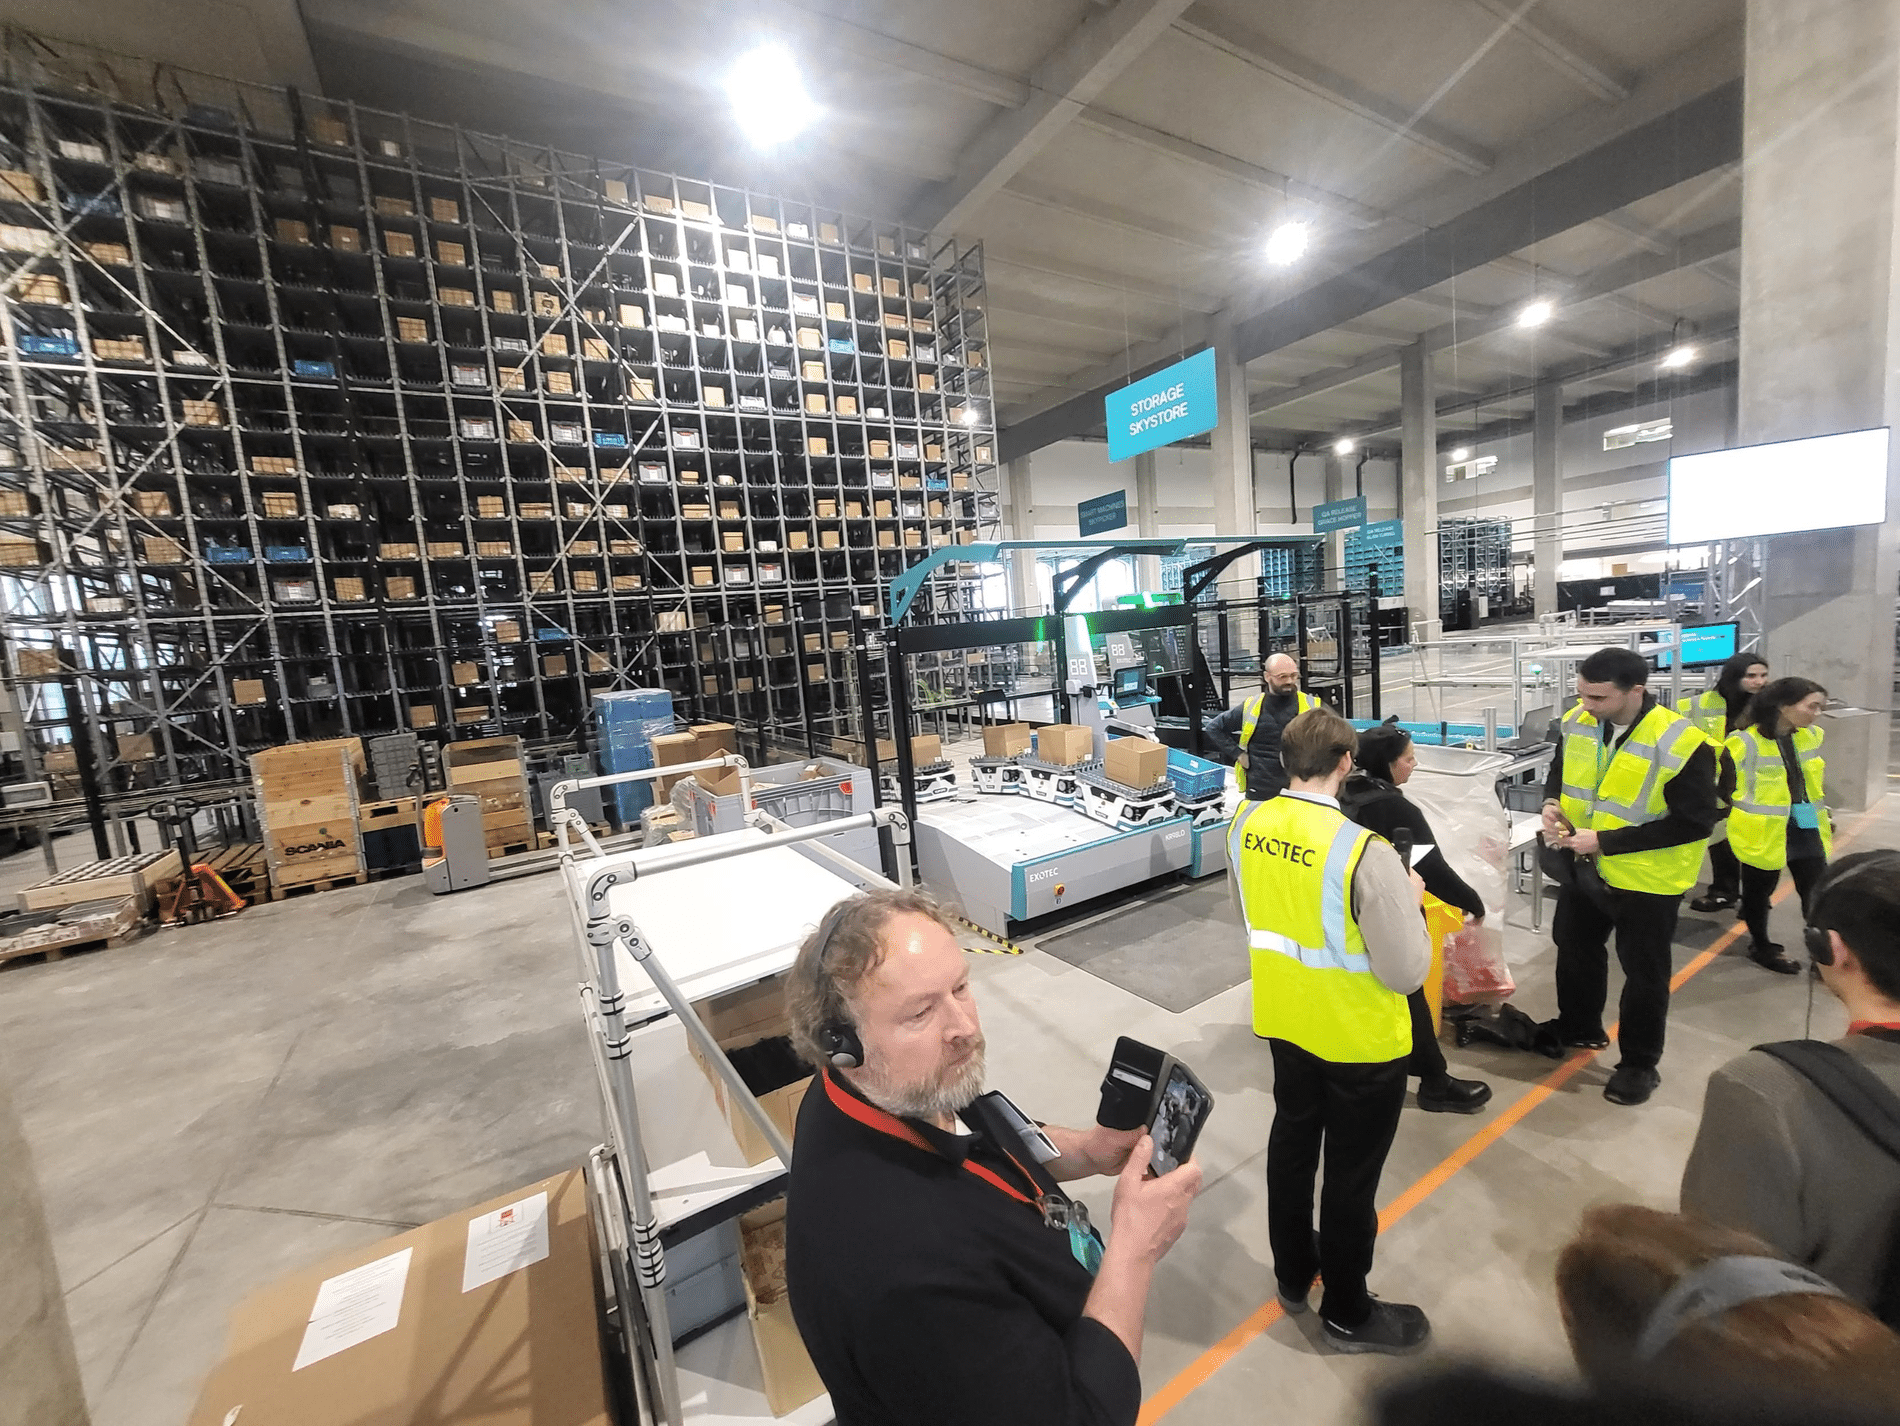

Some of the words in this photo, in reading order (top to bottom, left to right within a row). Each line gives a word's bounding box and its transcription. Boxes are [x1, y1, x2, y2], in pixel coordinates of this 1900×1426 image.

[1130, 382, 1185, 417] STORAGE
[1129, 402, 1188, 436] SKYSTORE
[284, 839, 346, 856] SCANIA
[1244, 832, 1316, 867] EXOTEC
[1029, 867, 1059, 883] EXOTEC
